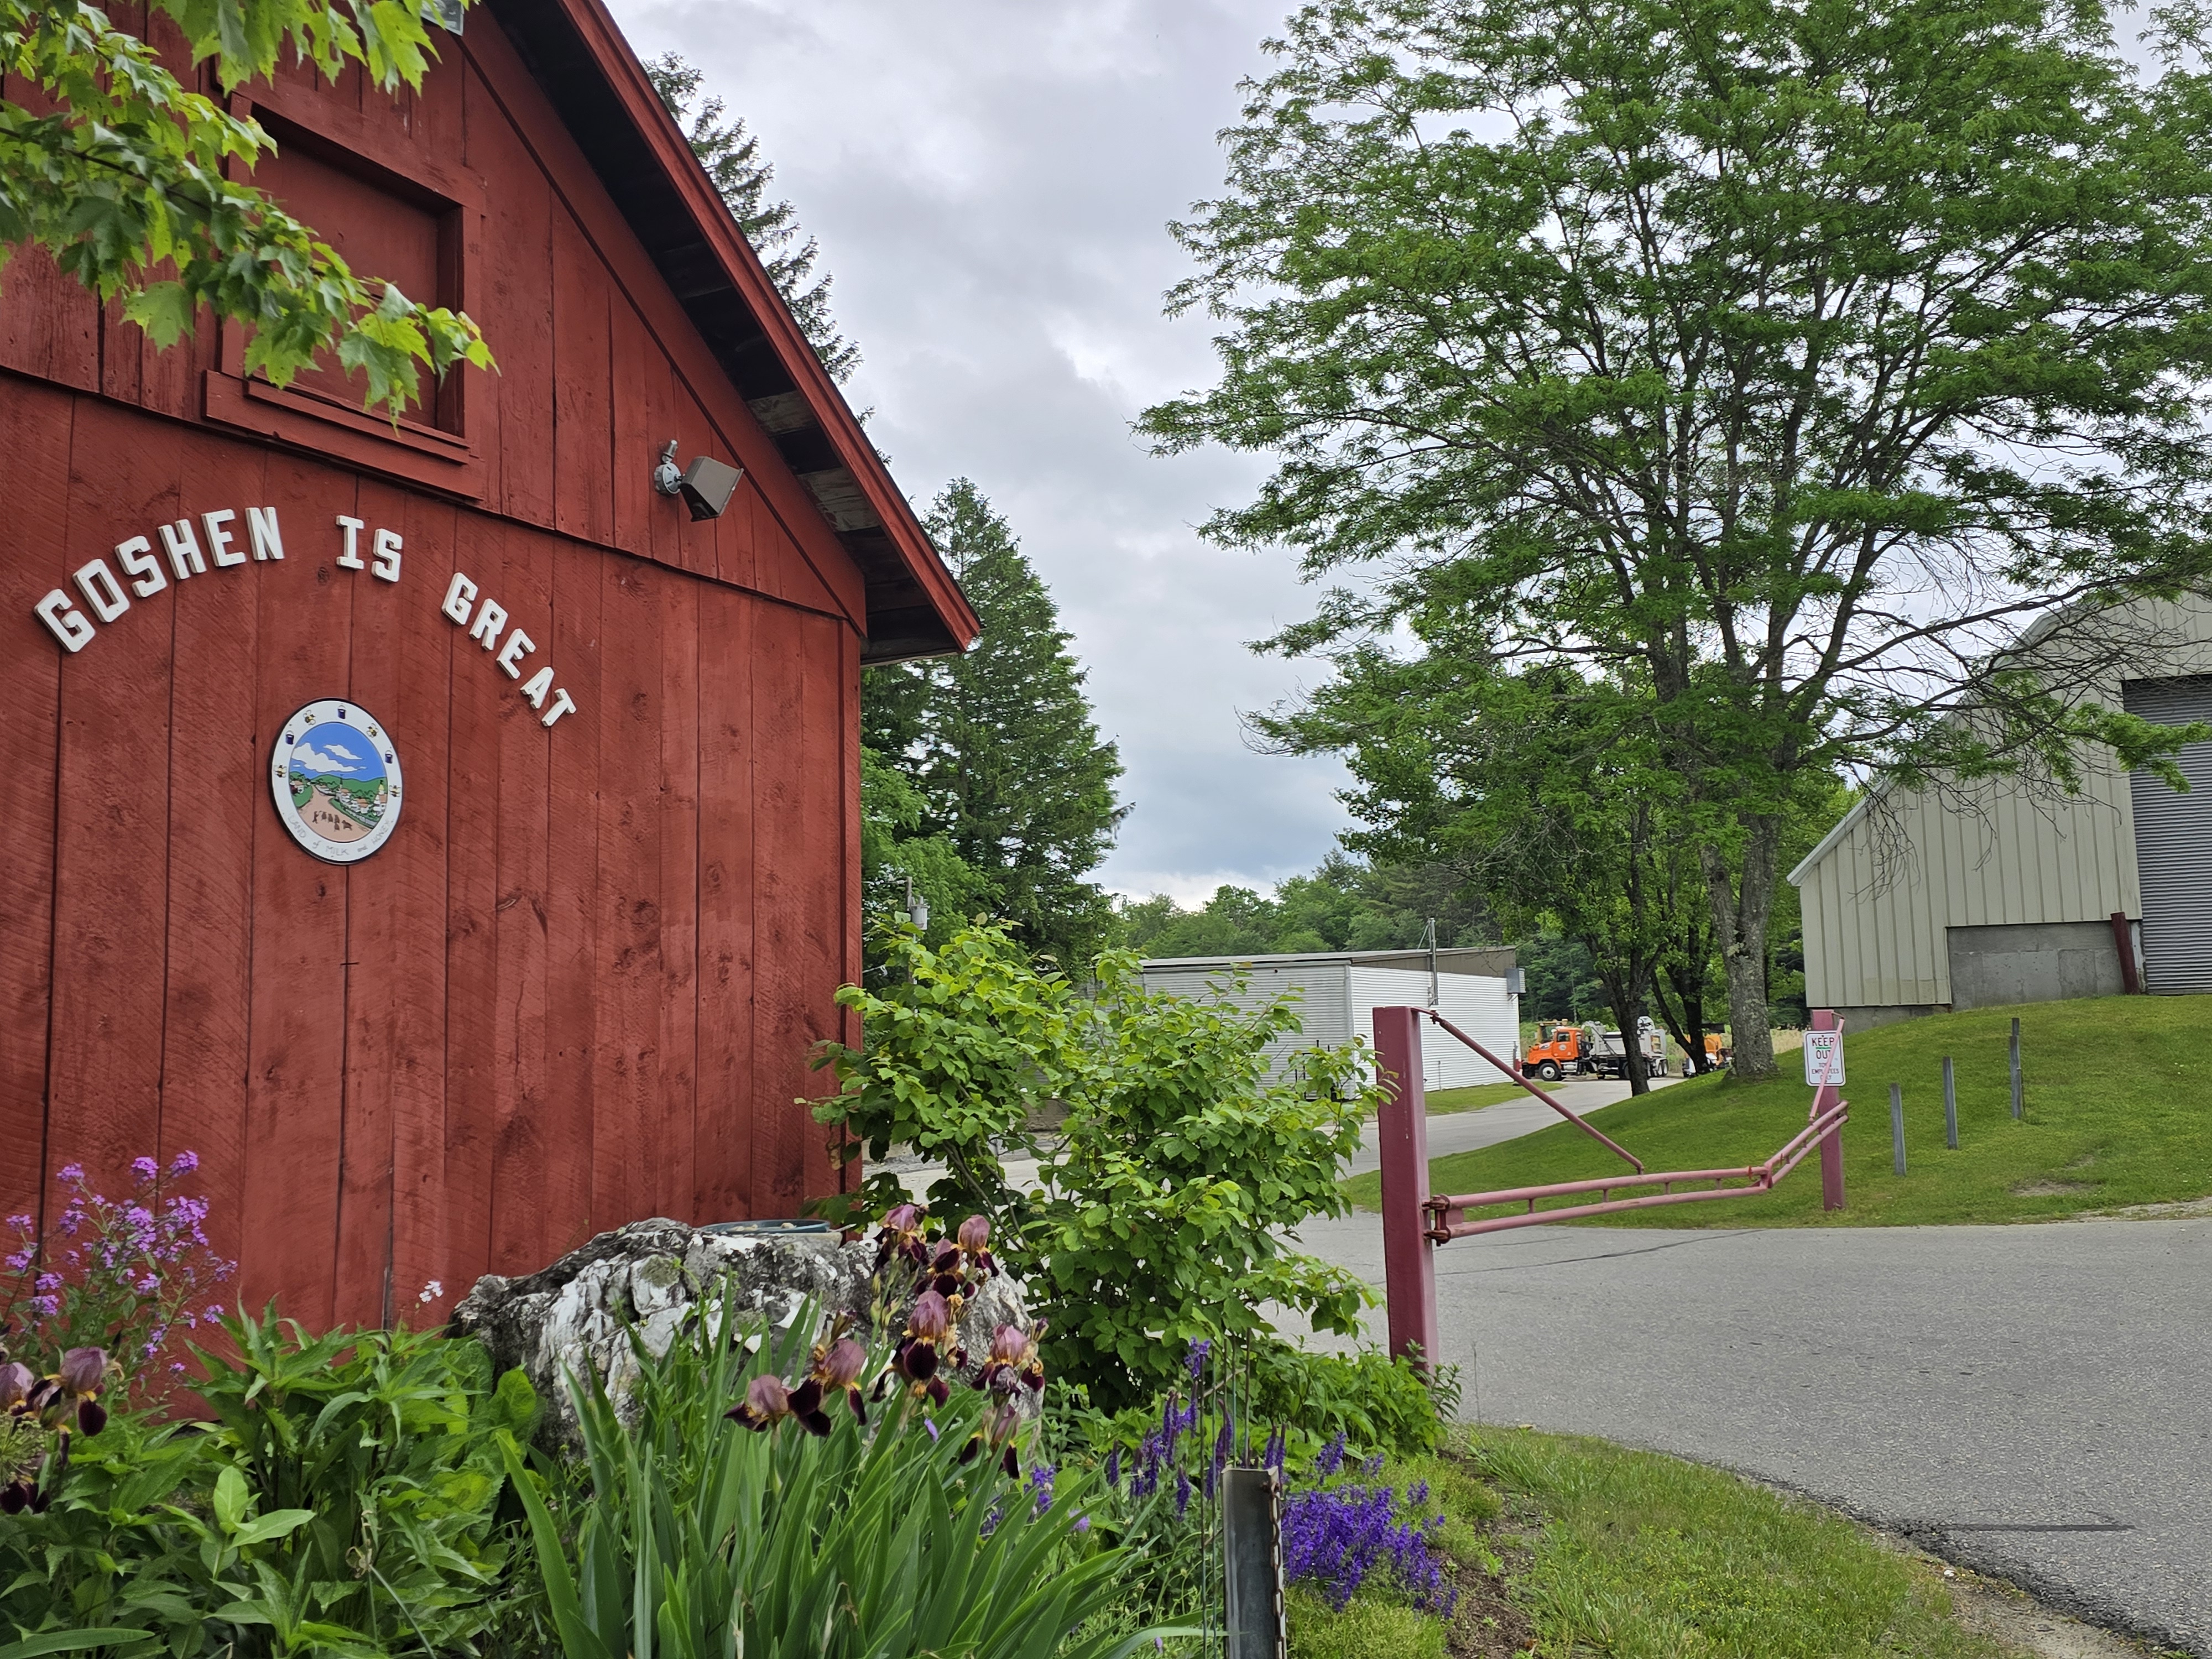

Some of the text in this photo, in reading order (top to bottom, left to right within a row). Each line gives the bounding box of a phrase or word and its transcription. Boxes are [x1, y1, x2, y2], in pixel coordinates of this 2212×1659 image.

[34, 507, 577, 727] GOSHEN IS GREAT
[1811, 1037, 1835, 1046] KEEP
